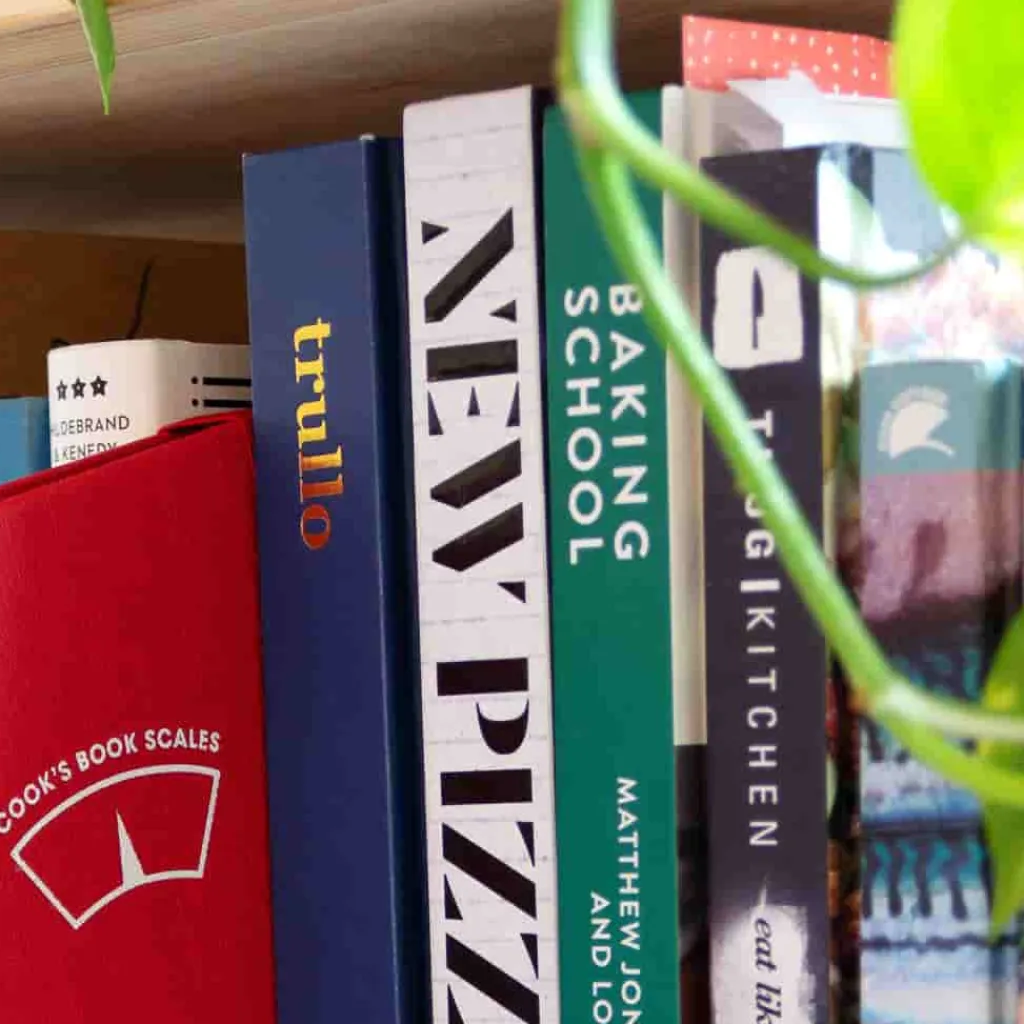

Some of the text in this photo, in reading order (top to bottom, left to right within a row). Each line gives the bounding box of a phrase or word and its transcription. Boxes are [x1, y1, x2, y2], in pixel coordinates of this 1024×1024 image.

[293, 318, 344, 551] trullo
[421, 206, 527, 605] NEW
[563, 286, 604, 564] SCHOOL
[608, 283, 651, 560] BAKING
[744, 411, 779, 848] TUG KITCHEN
[75, 732, 139, 772] BOOK
[144, 728, 221, 753] SCALES
[616, 776, 641, 951] MATTHEW
[589, 891, 611, 967] AND
[755, 917, 774, 975] eat
